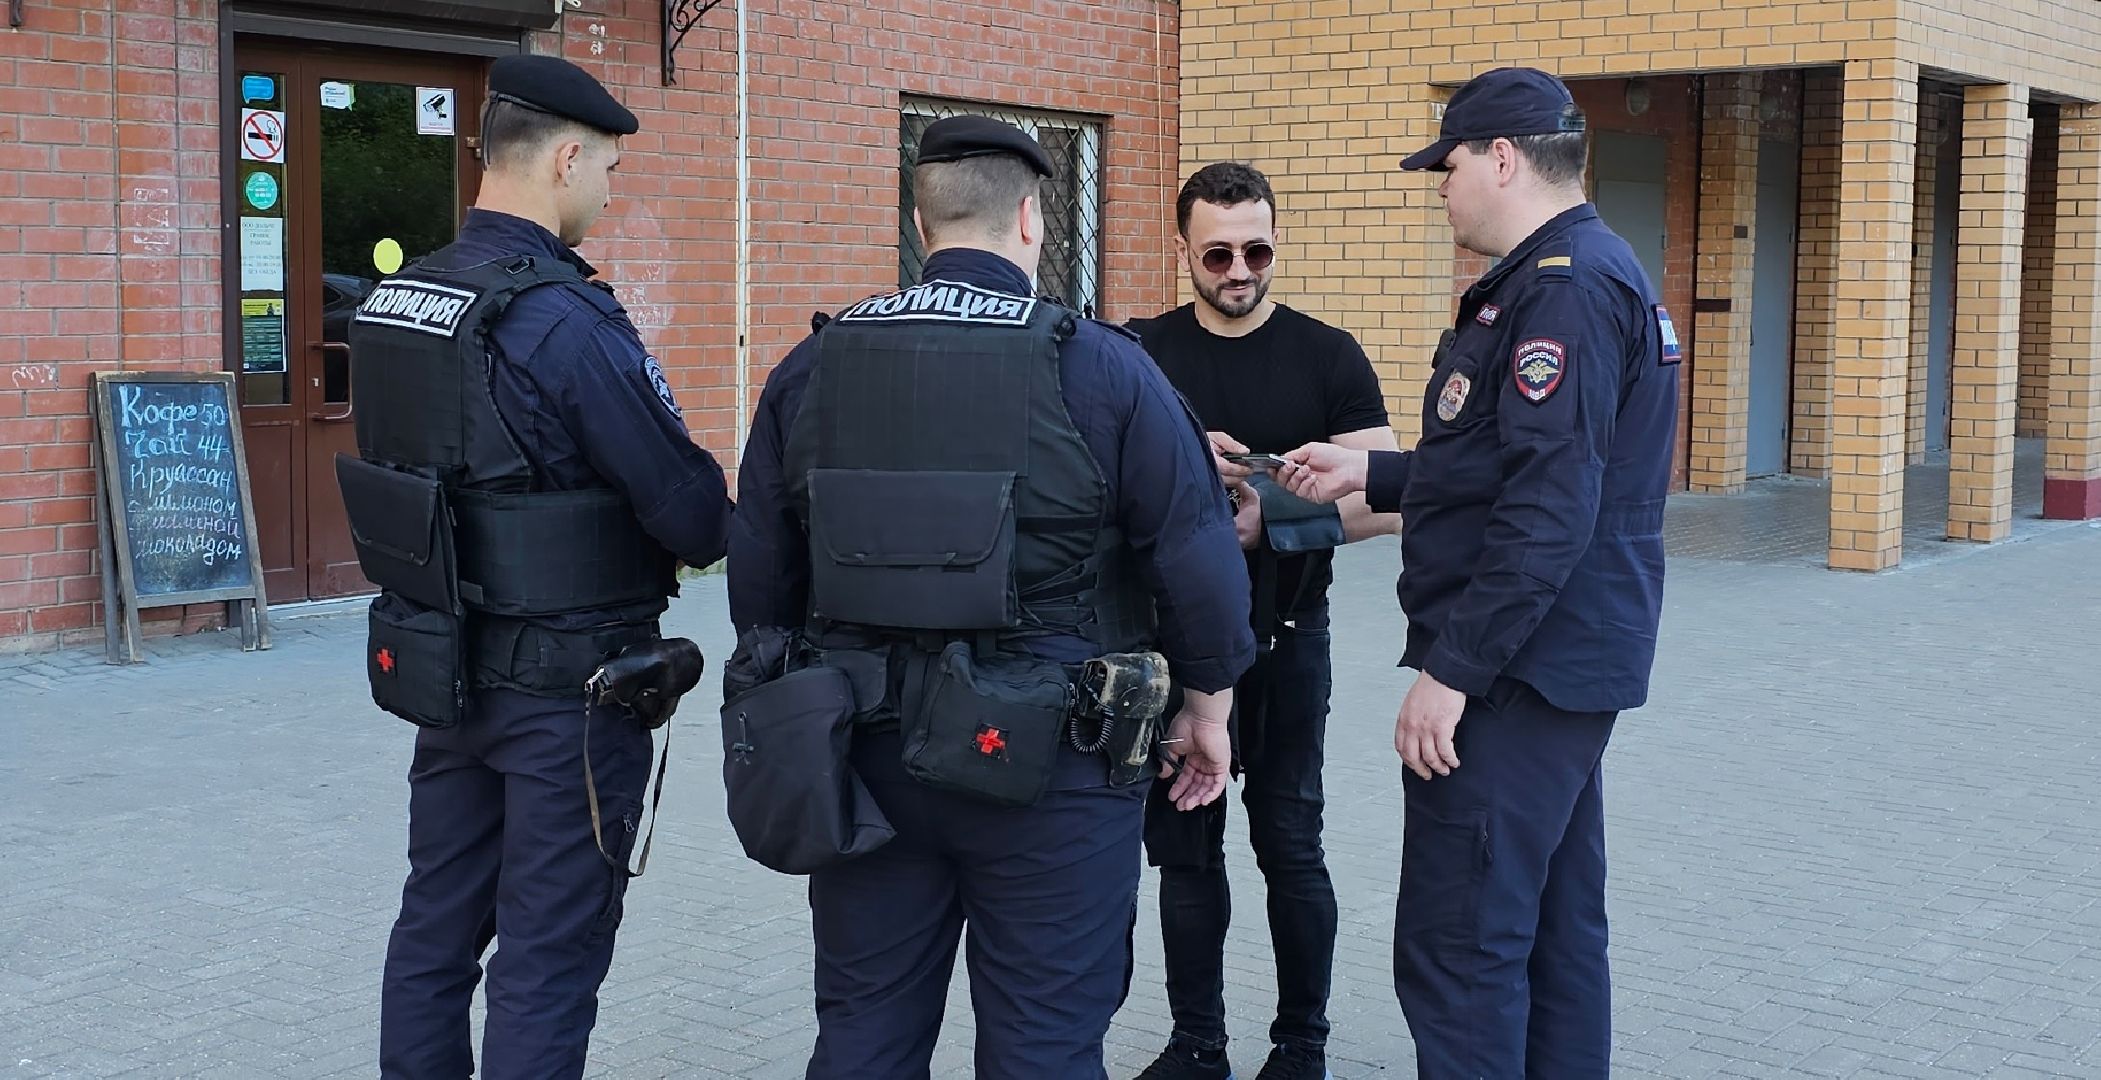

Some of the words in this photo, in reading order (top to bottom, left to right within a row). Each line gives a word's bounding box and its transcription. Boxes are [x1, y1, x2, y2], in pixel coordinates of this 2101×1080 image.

[363, 288, 465, 325] ПОЛИЦИЯ
[853, 286, 1023, 319] ПОЛИЦИЯ
[1518, 341, 1562, 356] ПОЛИЦИЯ
[1520, 351, 1558, 367] РОССИЯ
[119, 386, 198, 435] Кофе
[200, 403, 227, 426] 50
[125, 429, 192, 458] Чай
[131, 459, 232, 499] Круассан
[135, 533, 241, 566] шоколадом
